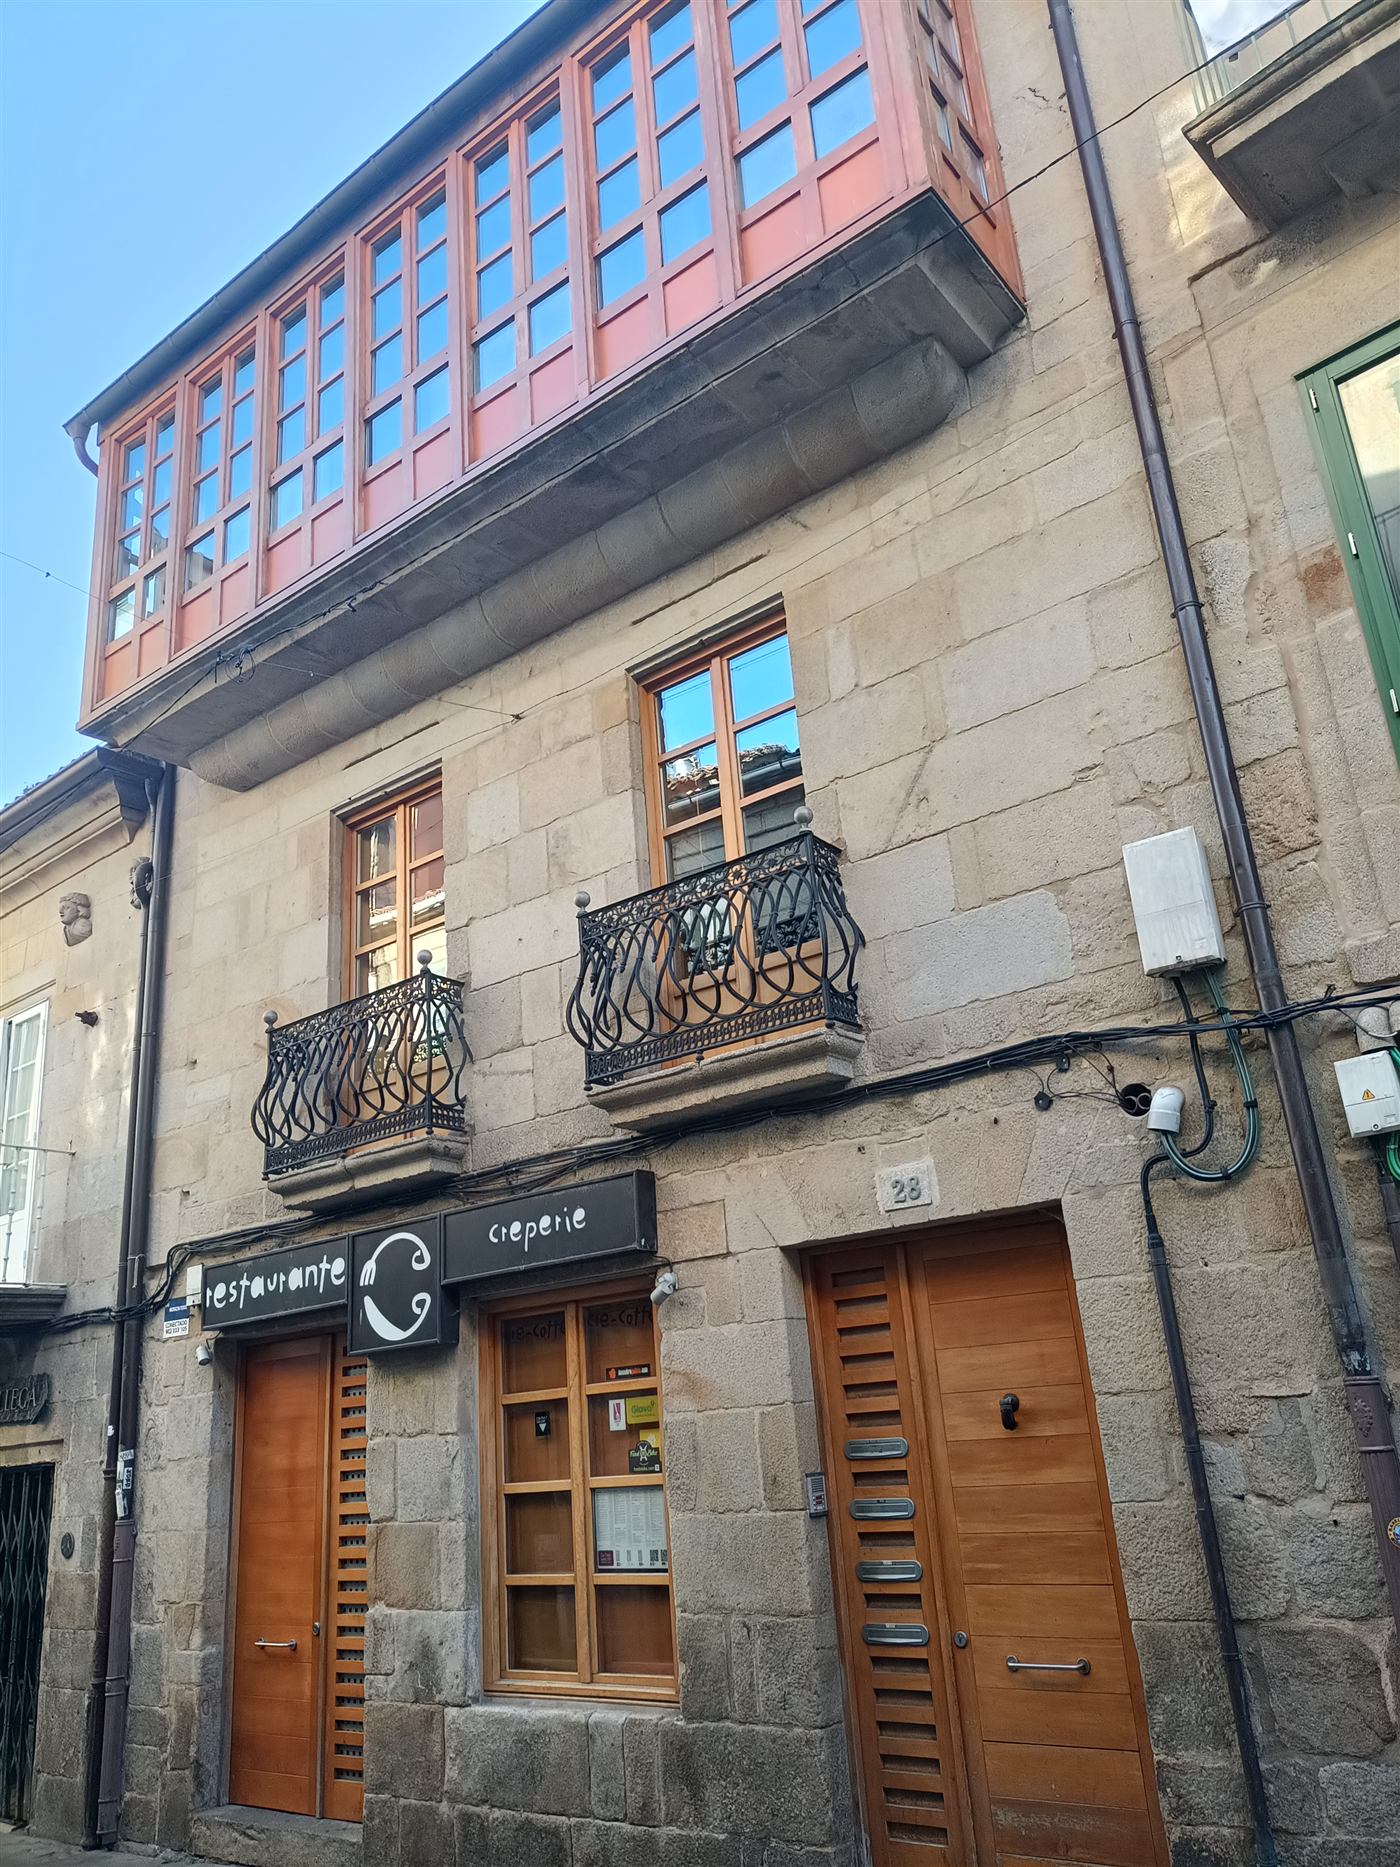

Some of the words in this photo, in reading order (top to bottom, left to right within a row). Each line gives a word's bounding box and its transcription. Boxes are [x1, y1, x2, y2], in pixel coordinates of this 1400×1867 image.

[891, 1176, 921, 1203] 28
[488, 1206, 586, 1252] creperie
[206, 1255, 345, 1309] restaurante
